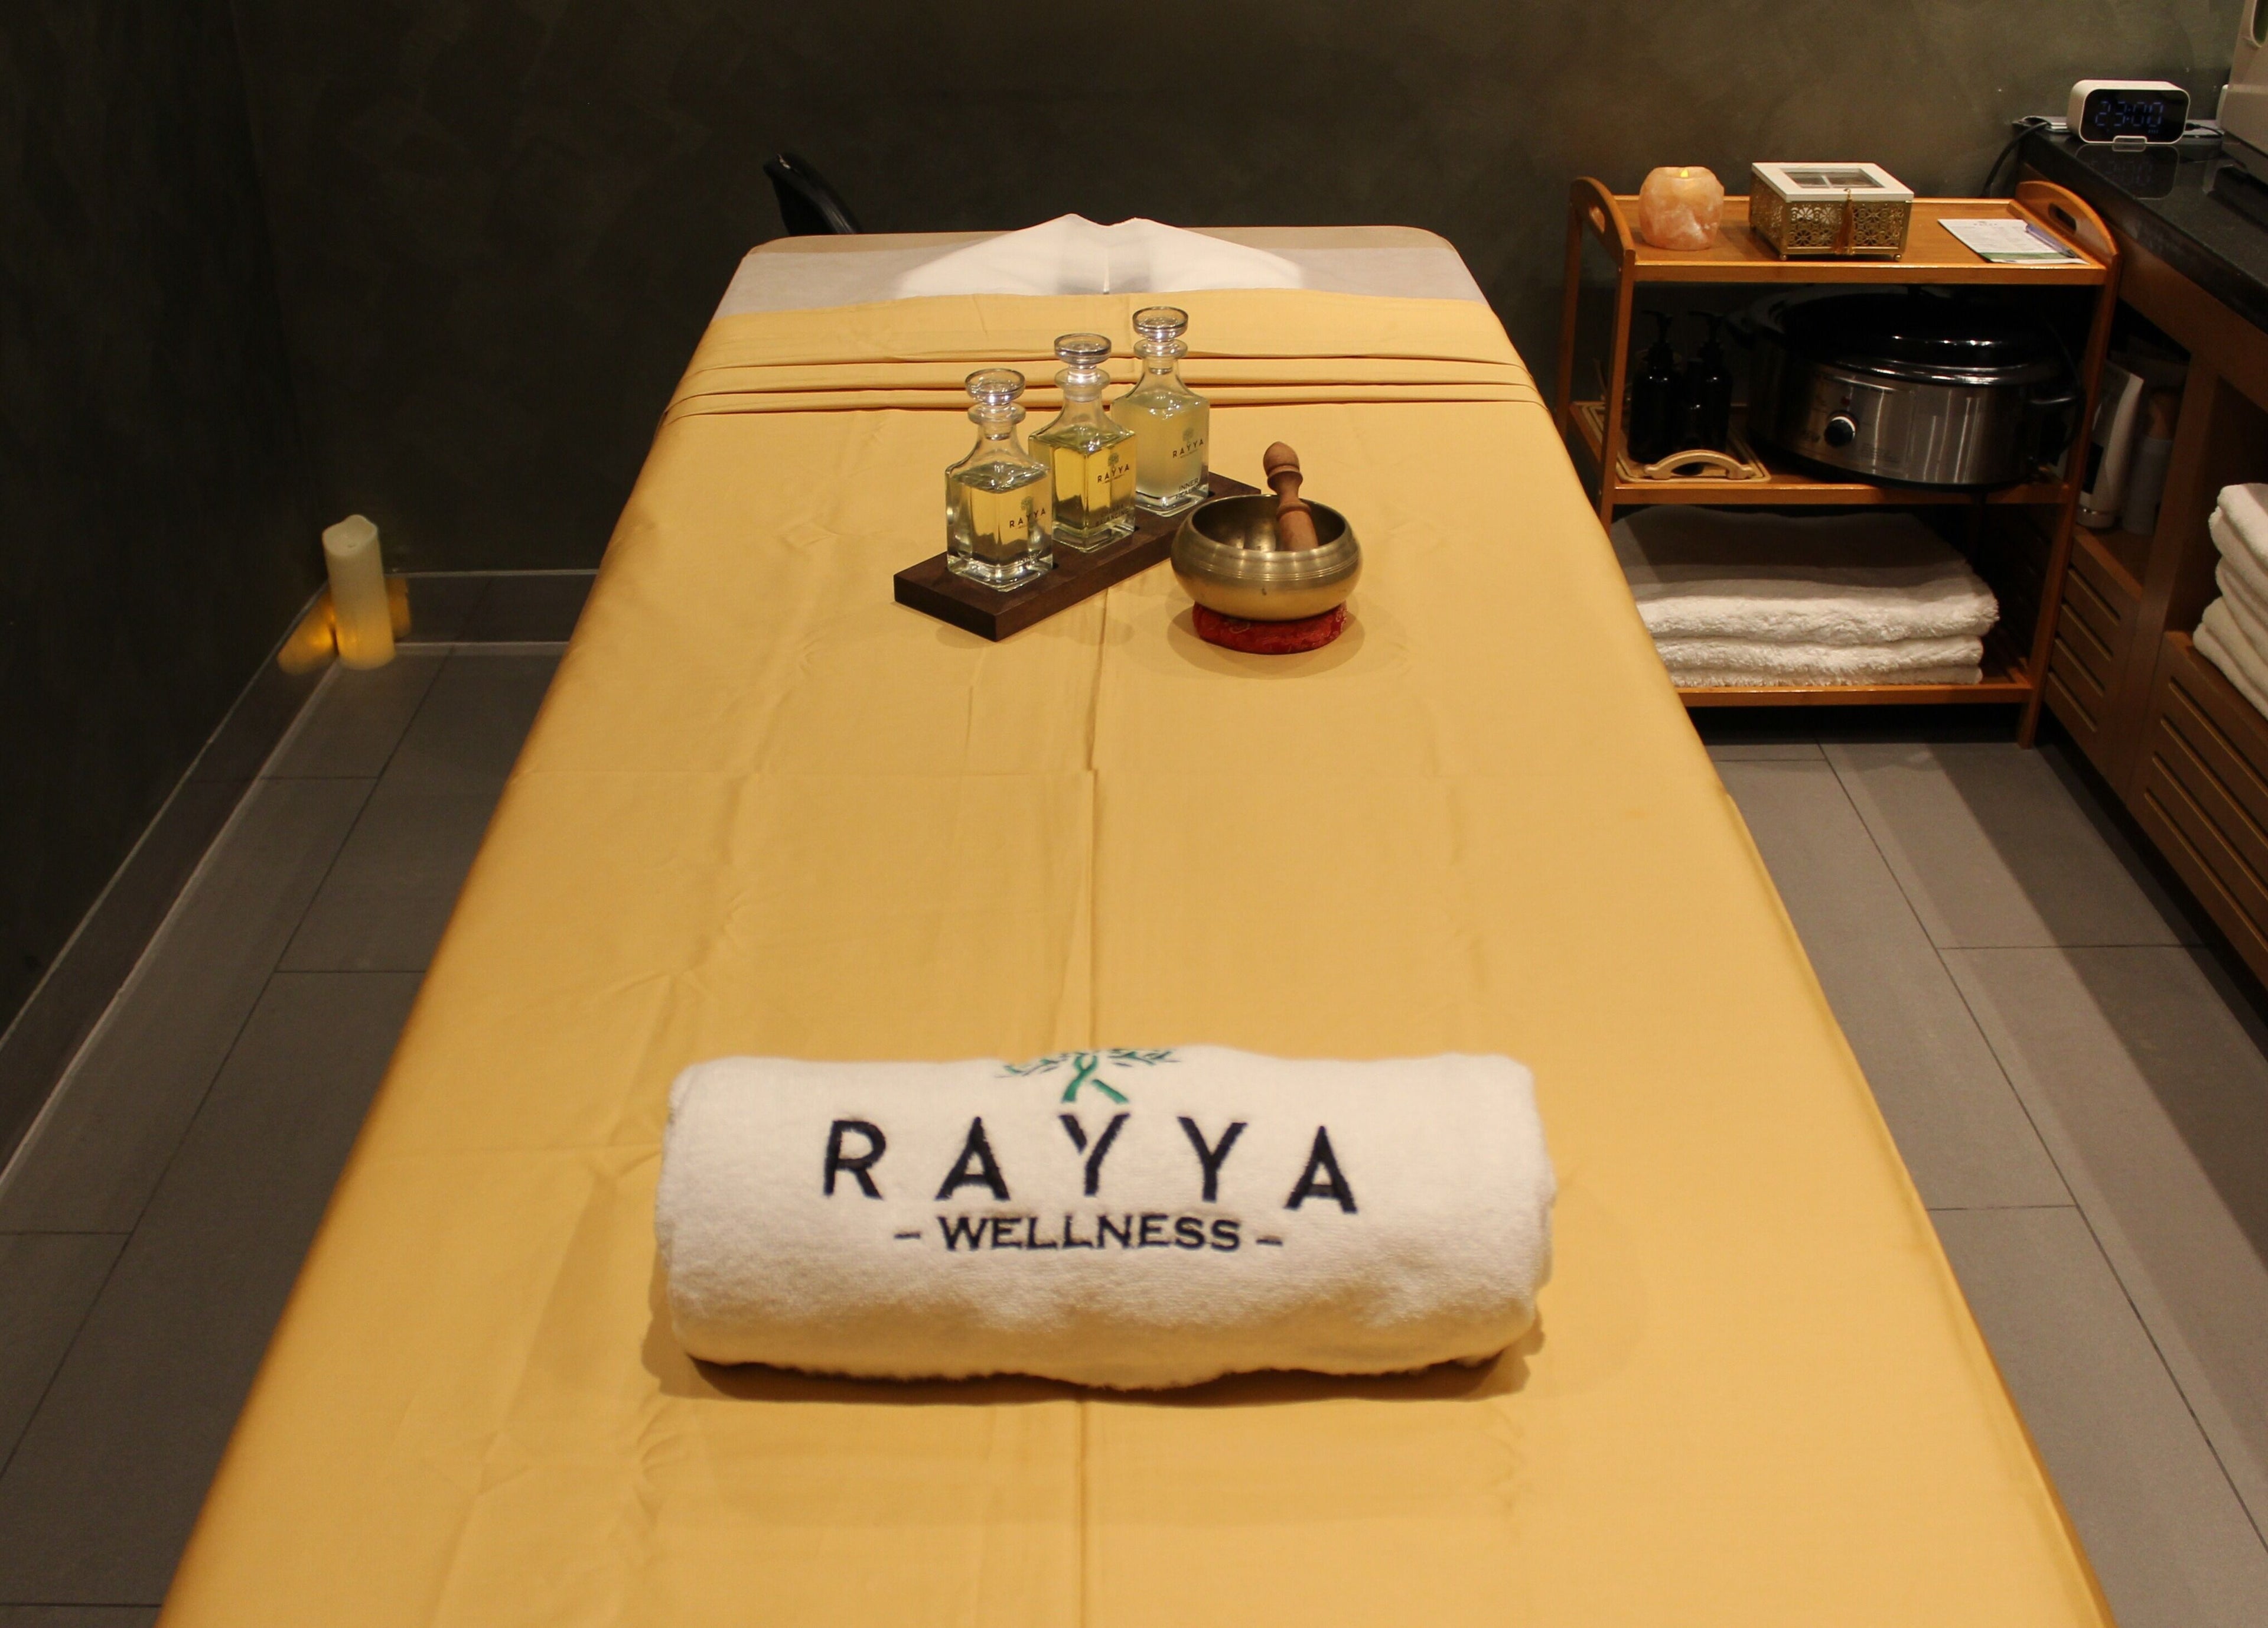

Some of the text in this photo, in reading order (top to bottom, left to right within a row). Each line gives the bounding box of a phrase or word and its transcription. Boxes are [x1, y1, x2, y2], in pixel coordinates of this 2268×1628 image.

[2094, 100, 2164, 128] 23:00
[1172, 438, 1204, 458] RAYYA
[1097, 463, 1130, 483] RAYYA
[1009, 507, 1047, 529] RAYYA
[822, 1112, 1360, 1215] RAYYA
[937, 1213, 1243, 1253] WELLNESS
